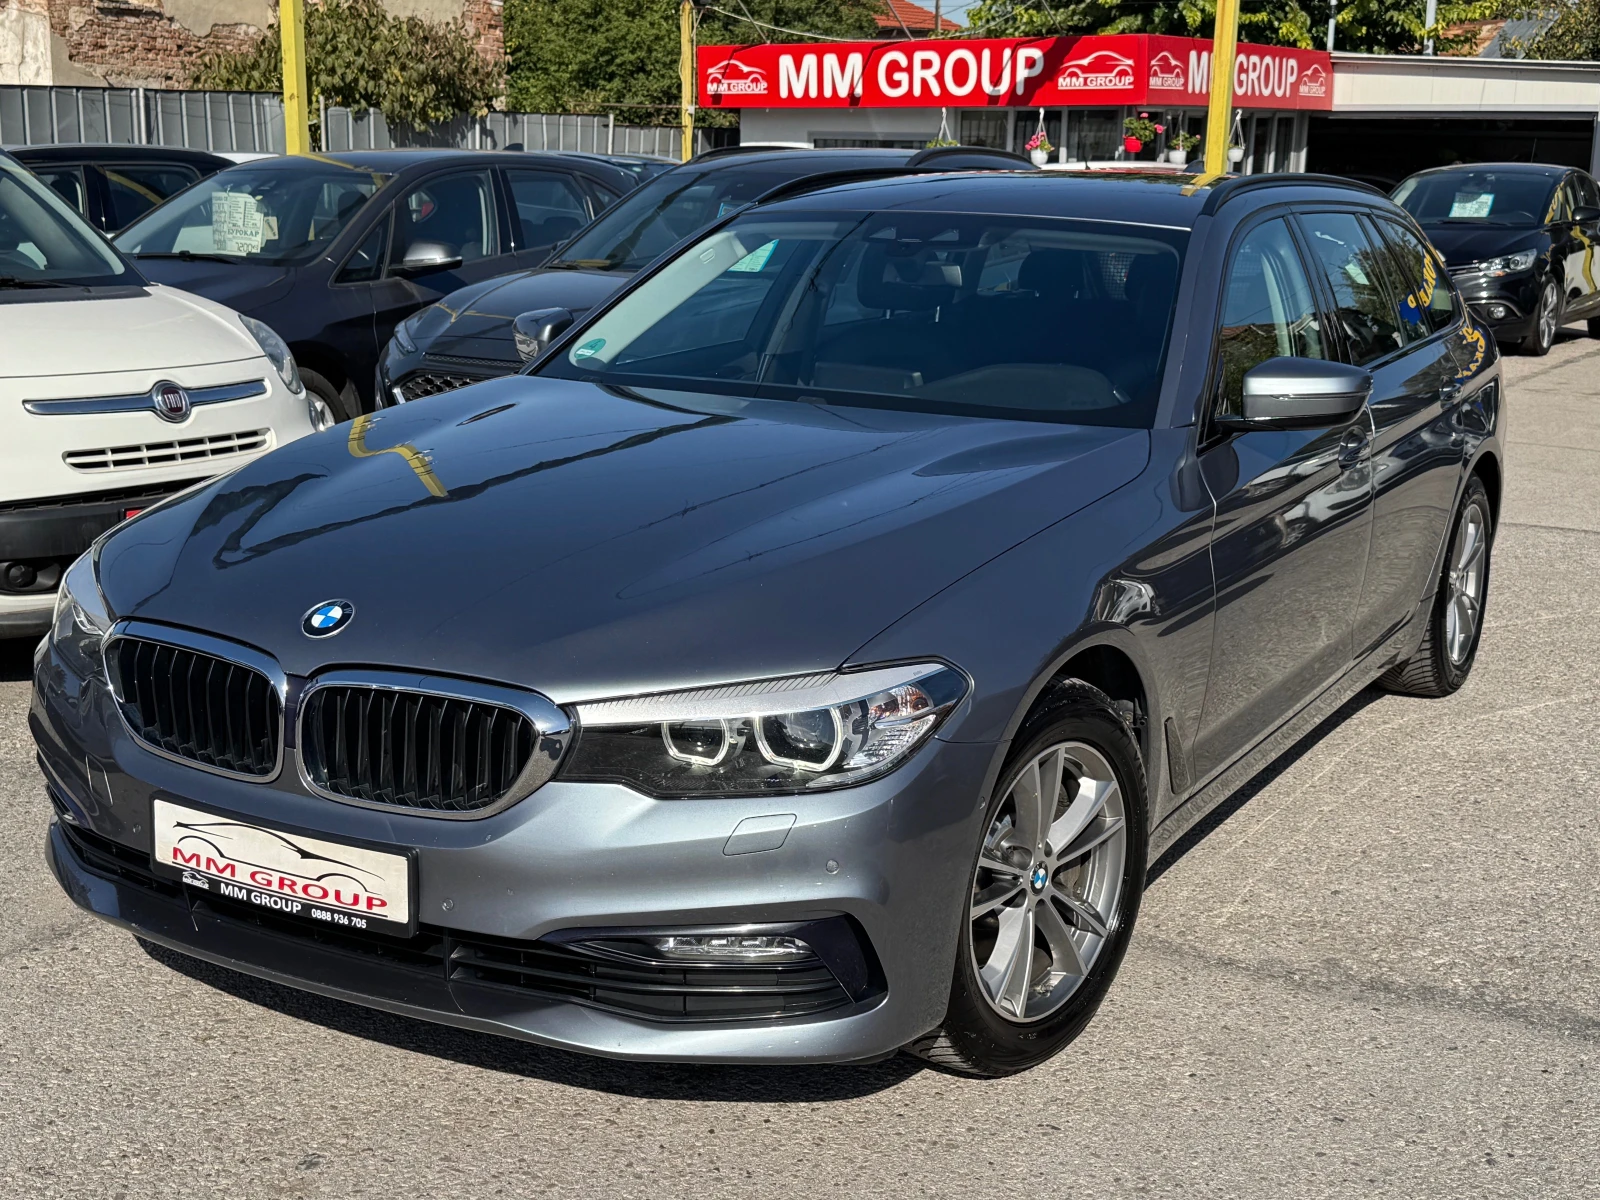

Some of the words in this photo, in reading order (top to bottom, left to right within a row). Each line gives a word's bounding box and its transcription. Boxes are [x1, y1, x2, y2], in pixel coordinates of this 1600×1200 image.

[707, 82, 728, 92] MM
[730, 82, 768, 92] GROUP
[778, 52, 863, 99] MM
[877, 47, 1044, 98] GROUP
[1057, 76, 1084, 87] MM
[1087, 75, 1134, 87] GROUP
[1149, 76, 1162, 86] MM
[1163, 77, 1184, 87] GROUP
[1187, 50, 1214, 94] M
[1233, 53, 1298, 98] GROUP
[172, 846, 236, 878] MM
[249, 870, 388, 911] GROUP
[220, 882, 247, 901] MM
[251, 890, 302, 914] GROUP
[311, 908, 332, 922] 0888
[334, 913, 349, 925] 936
[351, 916, 367, 929] 705
